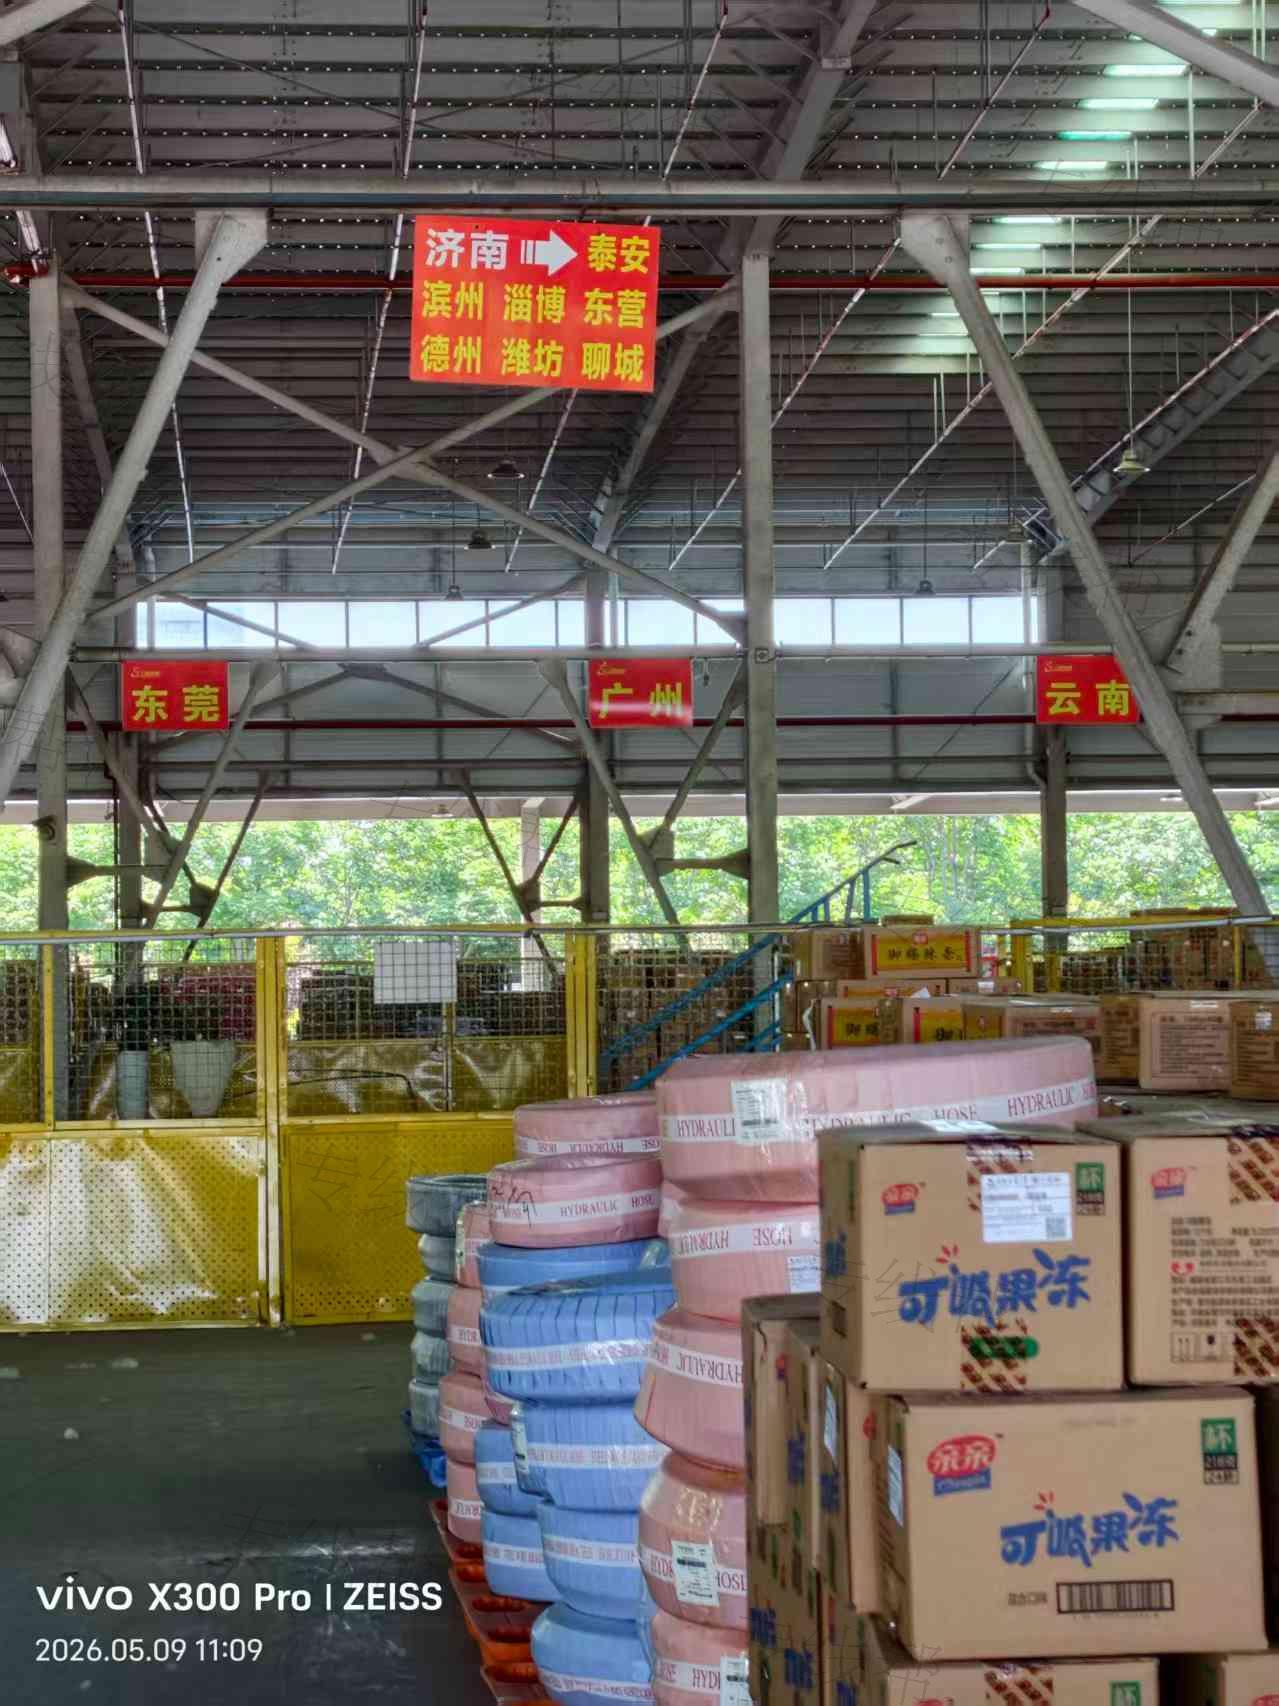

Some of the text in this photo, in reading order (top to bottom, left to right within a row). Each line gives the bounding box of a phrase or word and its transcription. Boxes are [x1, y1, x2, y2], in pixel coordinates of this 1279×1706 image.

[425, 228, 651, 274] 济南 泰安
[421, 279, 647, 329] 滨州 淄博 东营
[420, 333, 645, 382] 德州 潍坊 聊城
[131, 684, 220, 723] 东莞
[598, 682, 684, 719] 广州
[1045, 679, 1130, 716] 云南
[677, 1118, 736, 1137] HYDRAULI
[1007, 1086, 1074, 1118] HYDRAULIC
